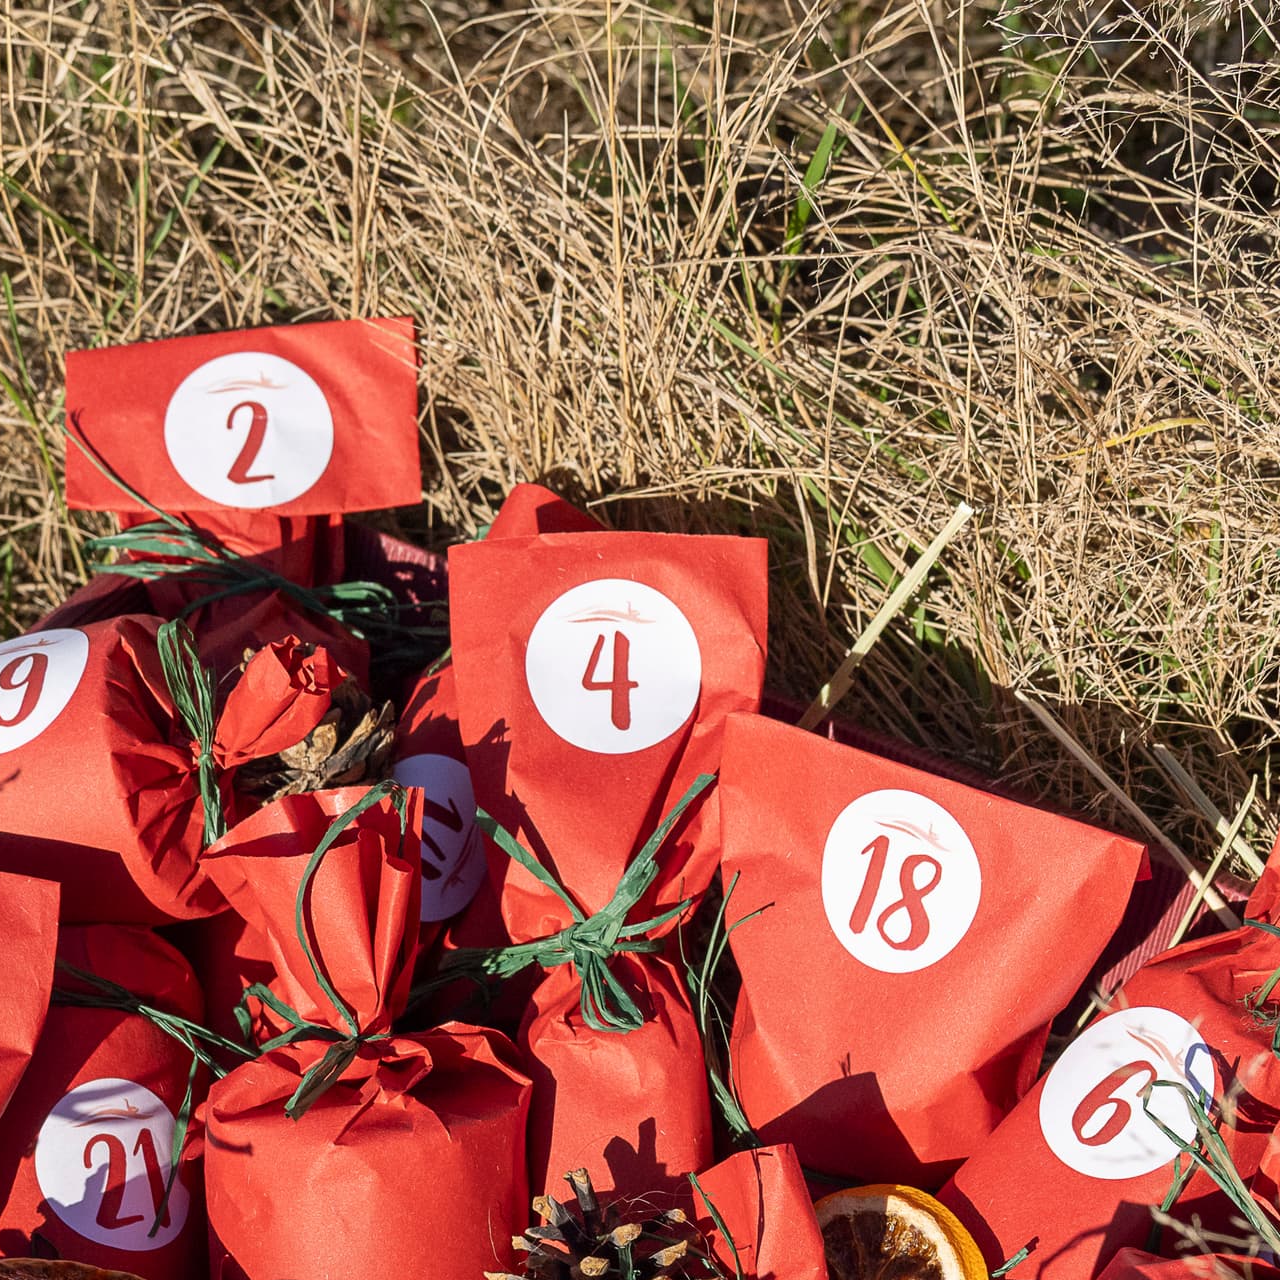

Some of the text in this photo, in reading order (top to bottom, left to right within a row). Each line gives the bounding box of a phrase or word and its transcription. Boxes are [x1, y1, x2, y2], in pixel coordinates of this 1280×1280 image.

[227, 401, 274, 484] 2
[582, 631, 638, 731] 4
[849, 835, 942, 951] 18
[1071, 1060, 1157, 1147] 6
[83, 1127, 171, 1230] 21
